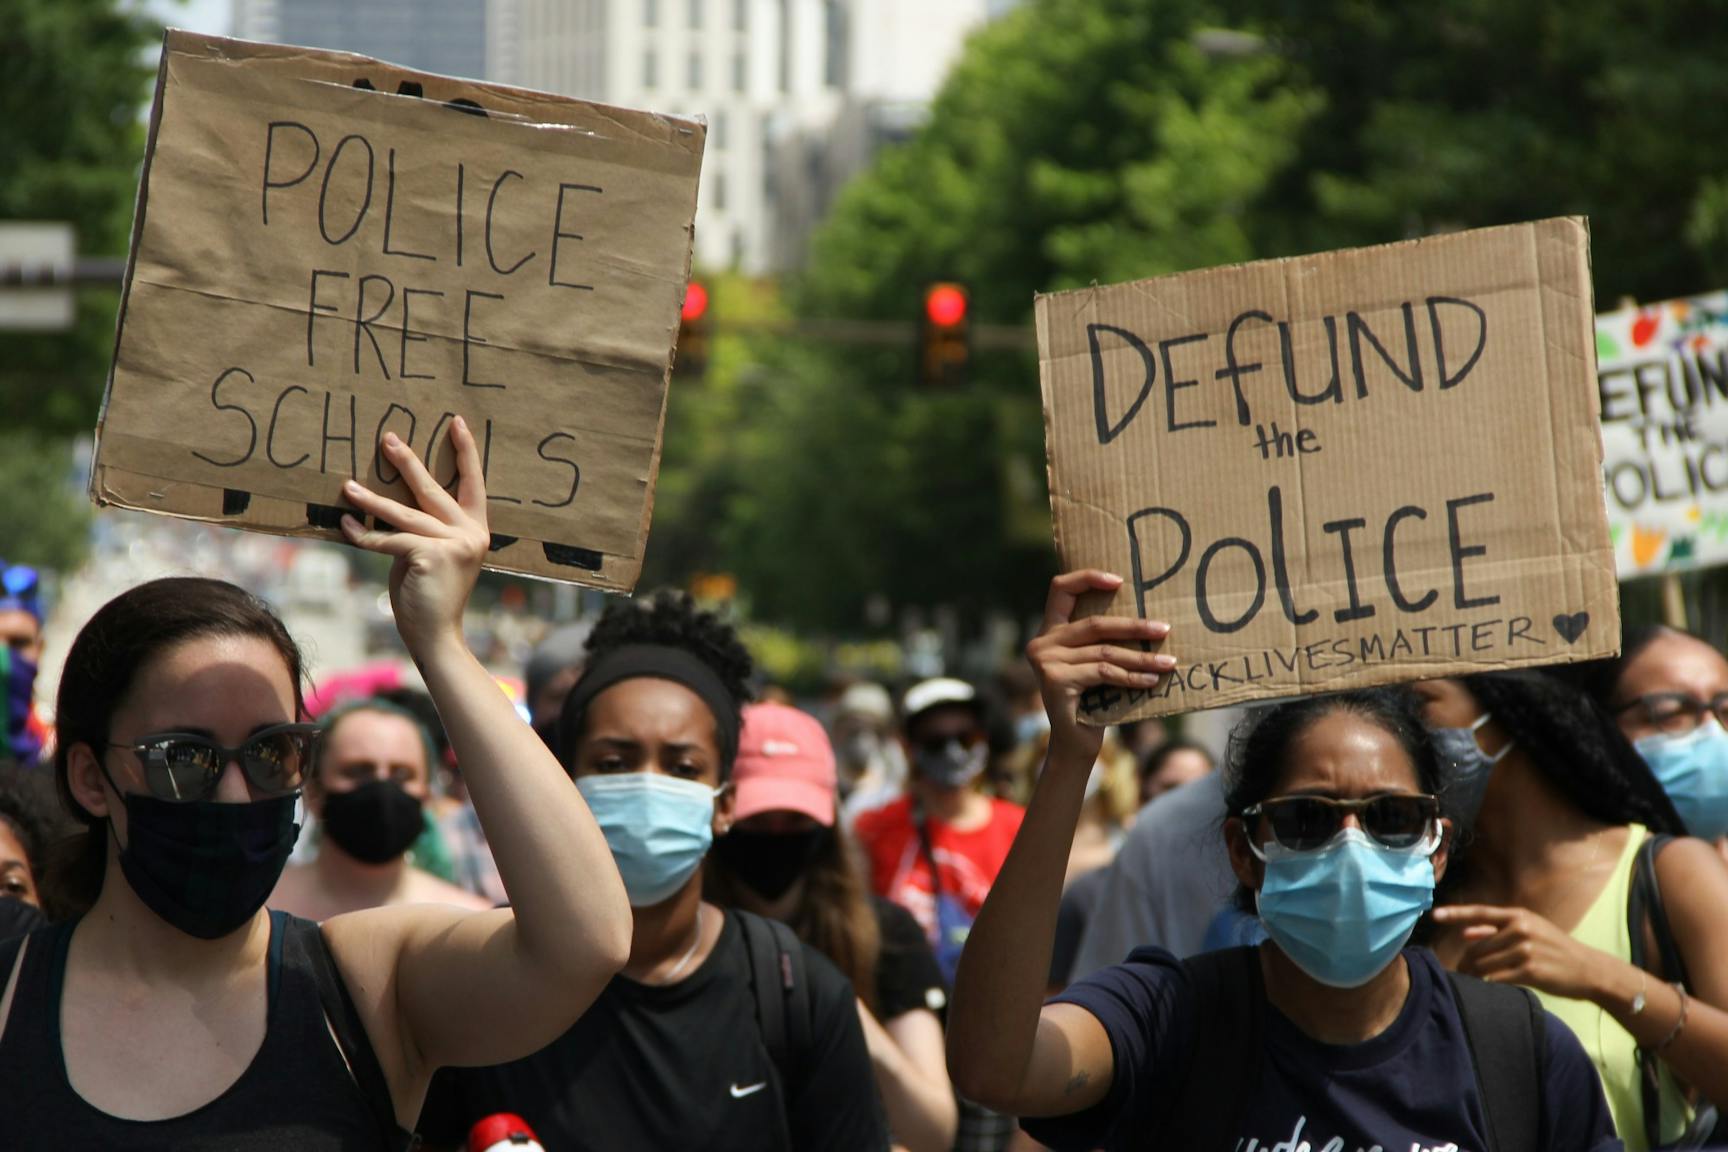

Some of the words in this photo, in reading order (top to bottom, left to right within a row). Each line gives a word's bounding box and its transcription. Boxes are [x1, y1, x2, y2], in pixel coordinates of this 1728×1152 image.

[261, 120, 604, 291] POLICE
[307, 268, 506, 390] FREE
[190, 366, 581, 508] SCHOOLS
[1253, 421, 1322, 460] the
[1603, 443, 1728, 510] OLIC
